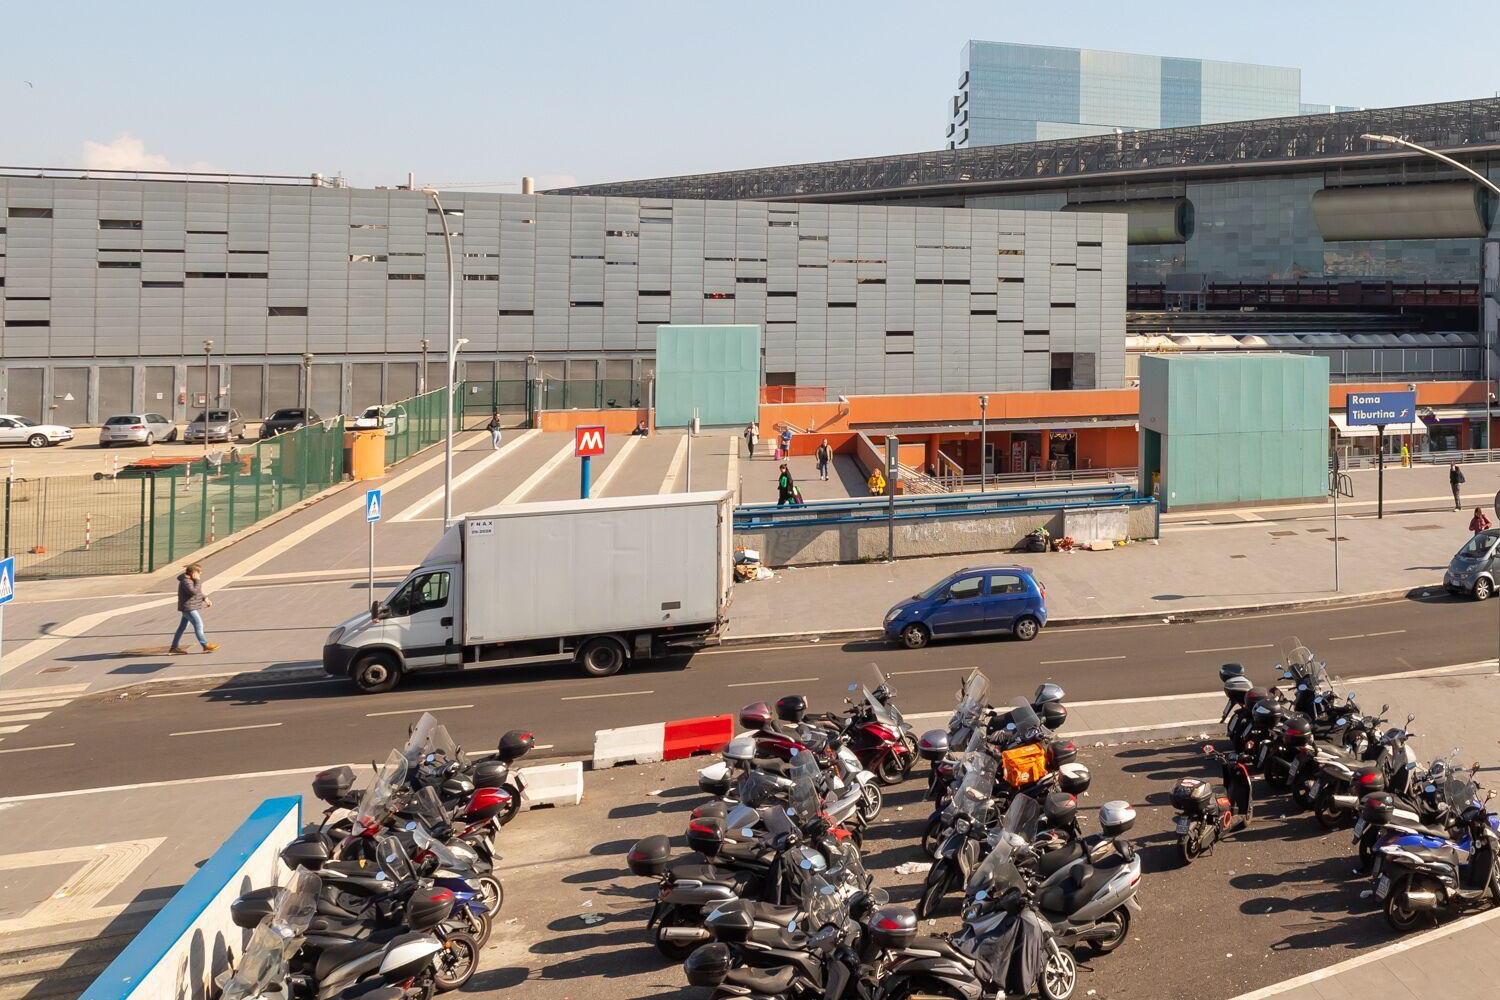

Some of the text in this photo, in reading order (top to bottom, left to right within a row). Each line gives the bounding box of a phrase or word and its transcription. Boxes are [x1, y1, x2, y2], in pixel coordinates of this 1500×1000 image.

[1352, 395, 1380, 405] Roma
[1352, 409, 1396, 420] Tiburtina
[578, 431, 604, 451] M
